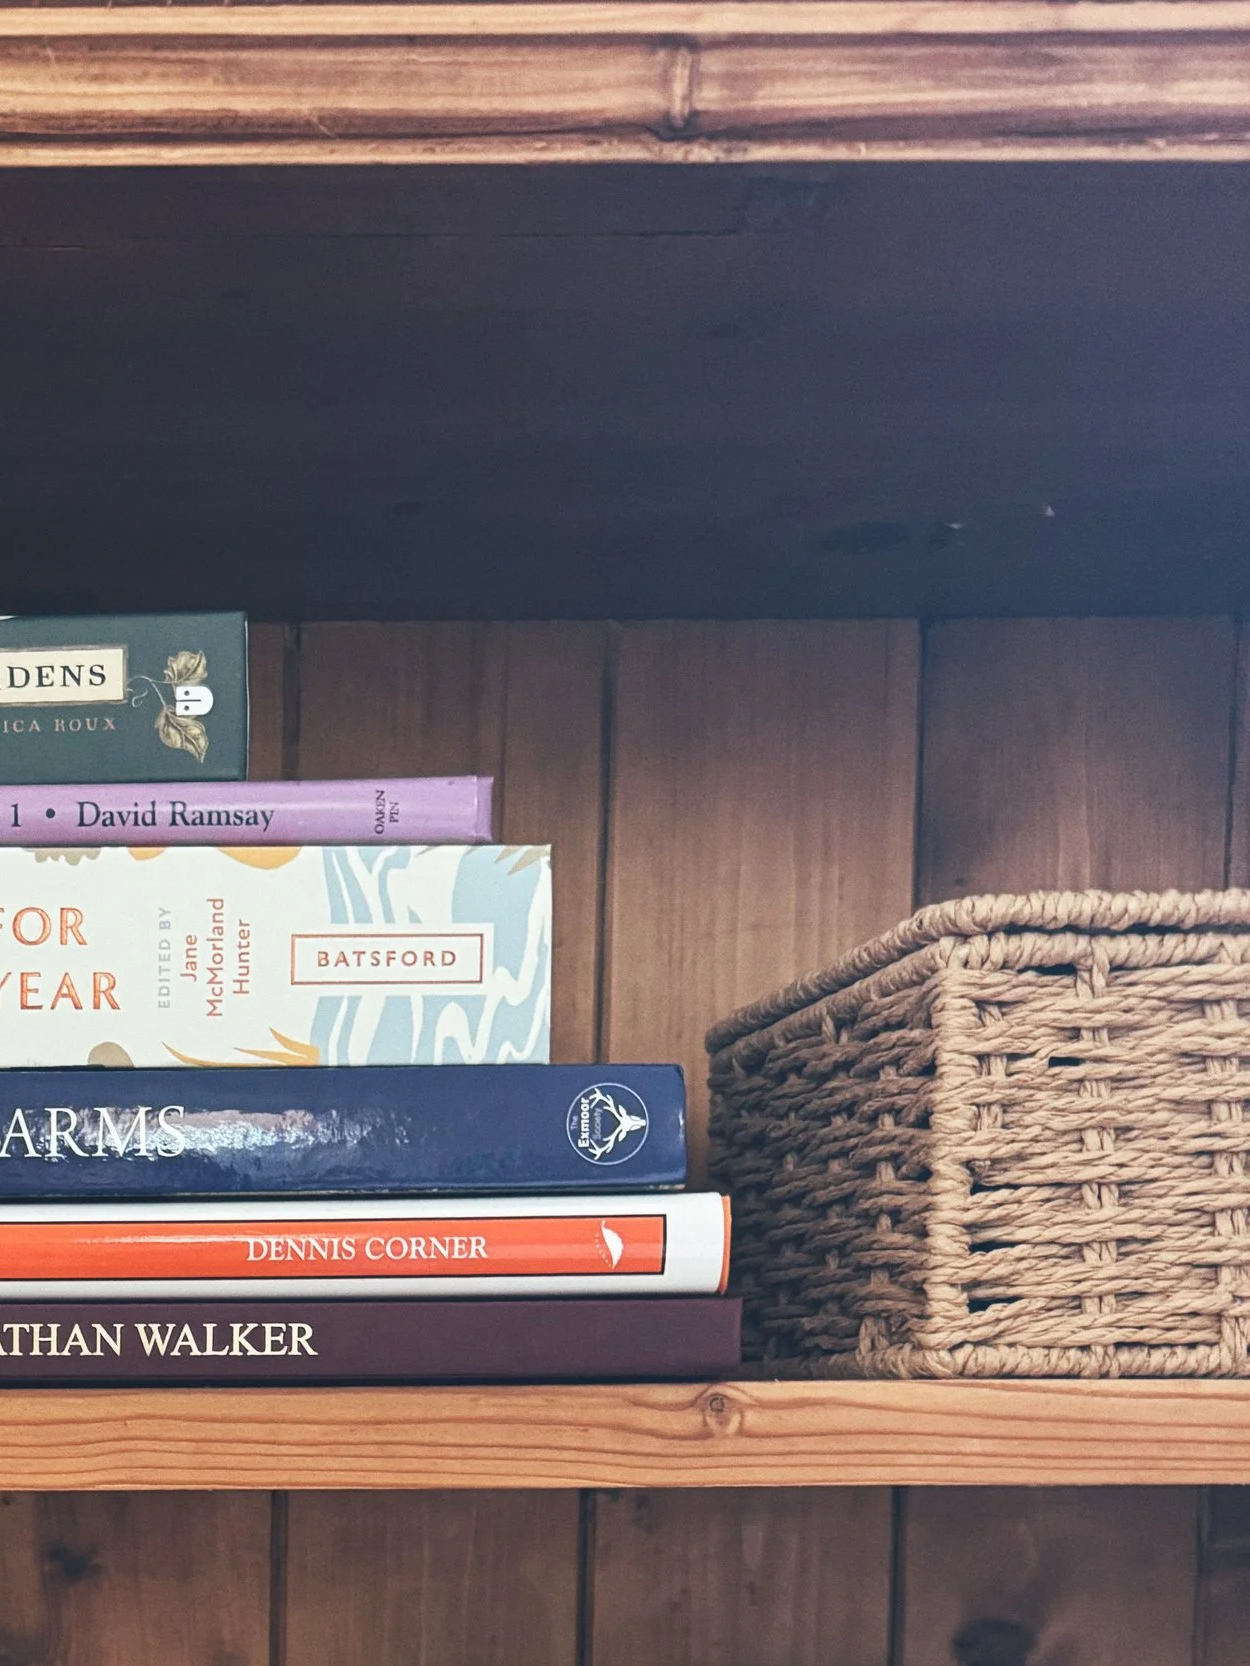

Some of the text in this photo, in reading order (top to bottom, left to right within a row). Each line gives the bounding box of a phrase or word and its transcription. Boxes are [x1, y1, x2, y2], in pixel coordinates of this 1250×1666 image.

[54, 716, 117, 733] ROUX
[9, 802, 22, 828] 1
[77, 799, 158, 828] David
[168, 798, 275, 833] Ramsay
[374, 789, 385, 835] OAKEN
[158, 906, 172, 1009] EDITED BY
[180, 934, 198, 982] Jane
[206, 897, 224, 1017] McMorland
[232, 918, 250, 994] Hunter
[317, 949, 458, 969] BATSFORD
[578, 1097, 590, 1148] Exmoor
[246, 1234, 488, 1262] DENNIS CORNER
[134, 1323, 318, 1356] WALKER
